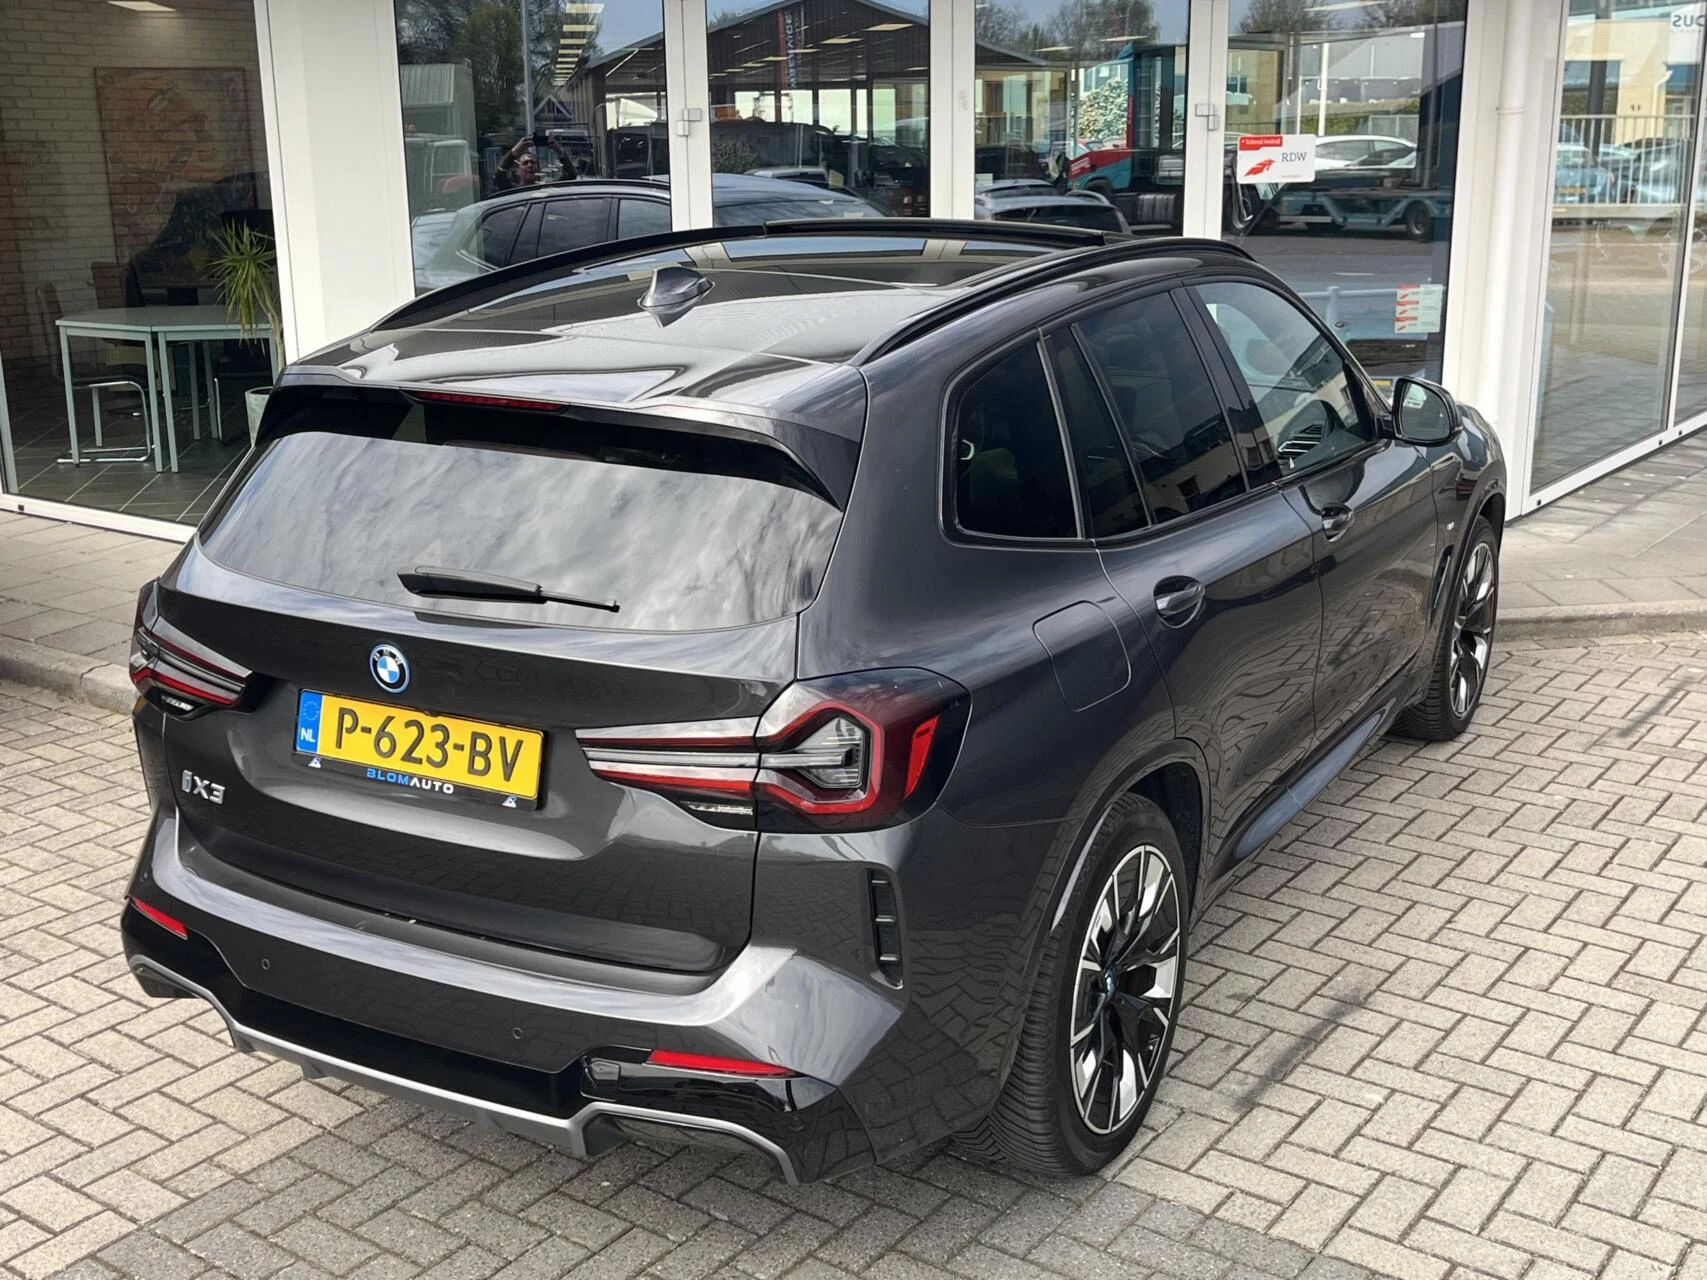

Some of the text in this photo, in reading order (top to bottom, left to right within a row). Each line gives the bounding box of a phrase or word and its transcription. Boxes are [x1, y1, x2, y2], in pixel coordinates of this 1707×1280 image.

[1281, 151, 1307, 162] RDW
[373, 648, 402, 665] BMW
[300, 728, 316, 743] NL
[335, 706, 524, 782] P-623-BV
[182, 769, 226, 805] iX3
[366, 768, 454, 794] BLOMAUTO
